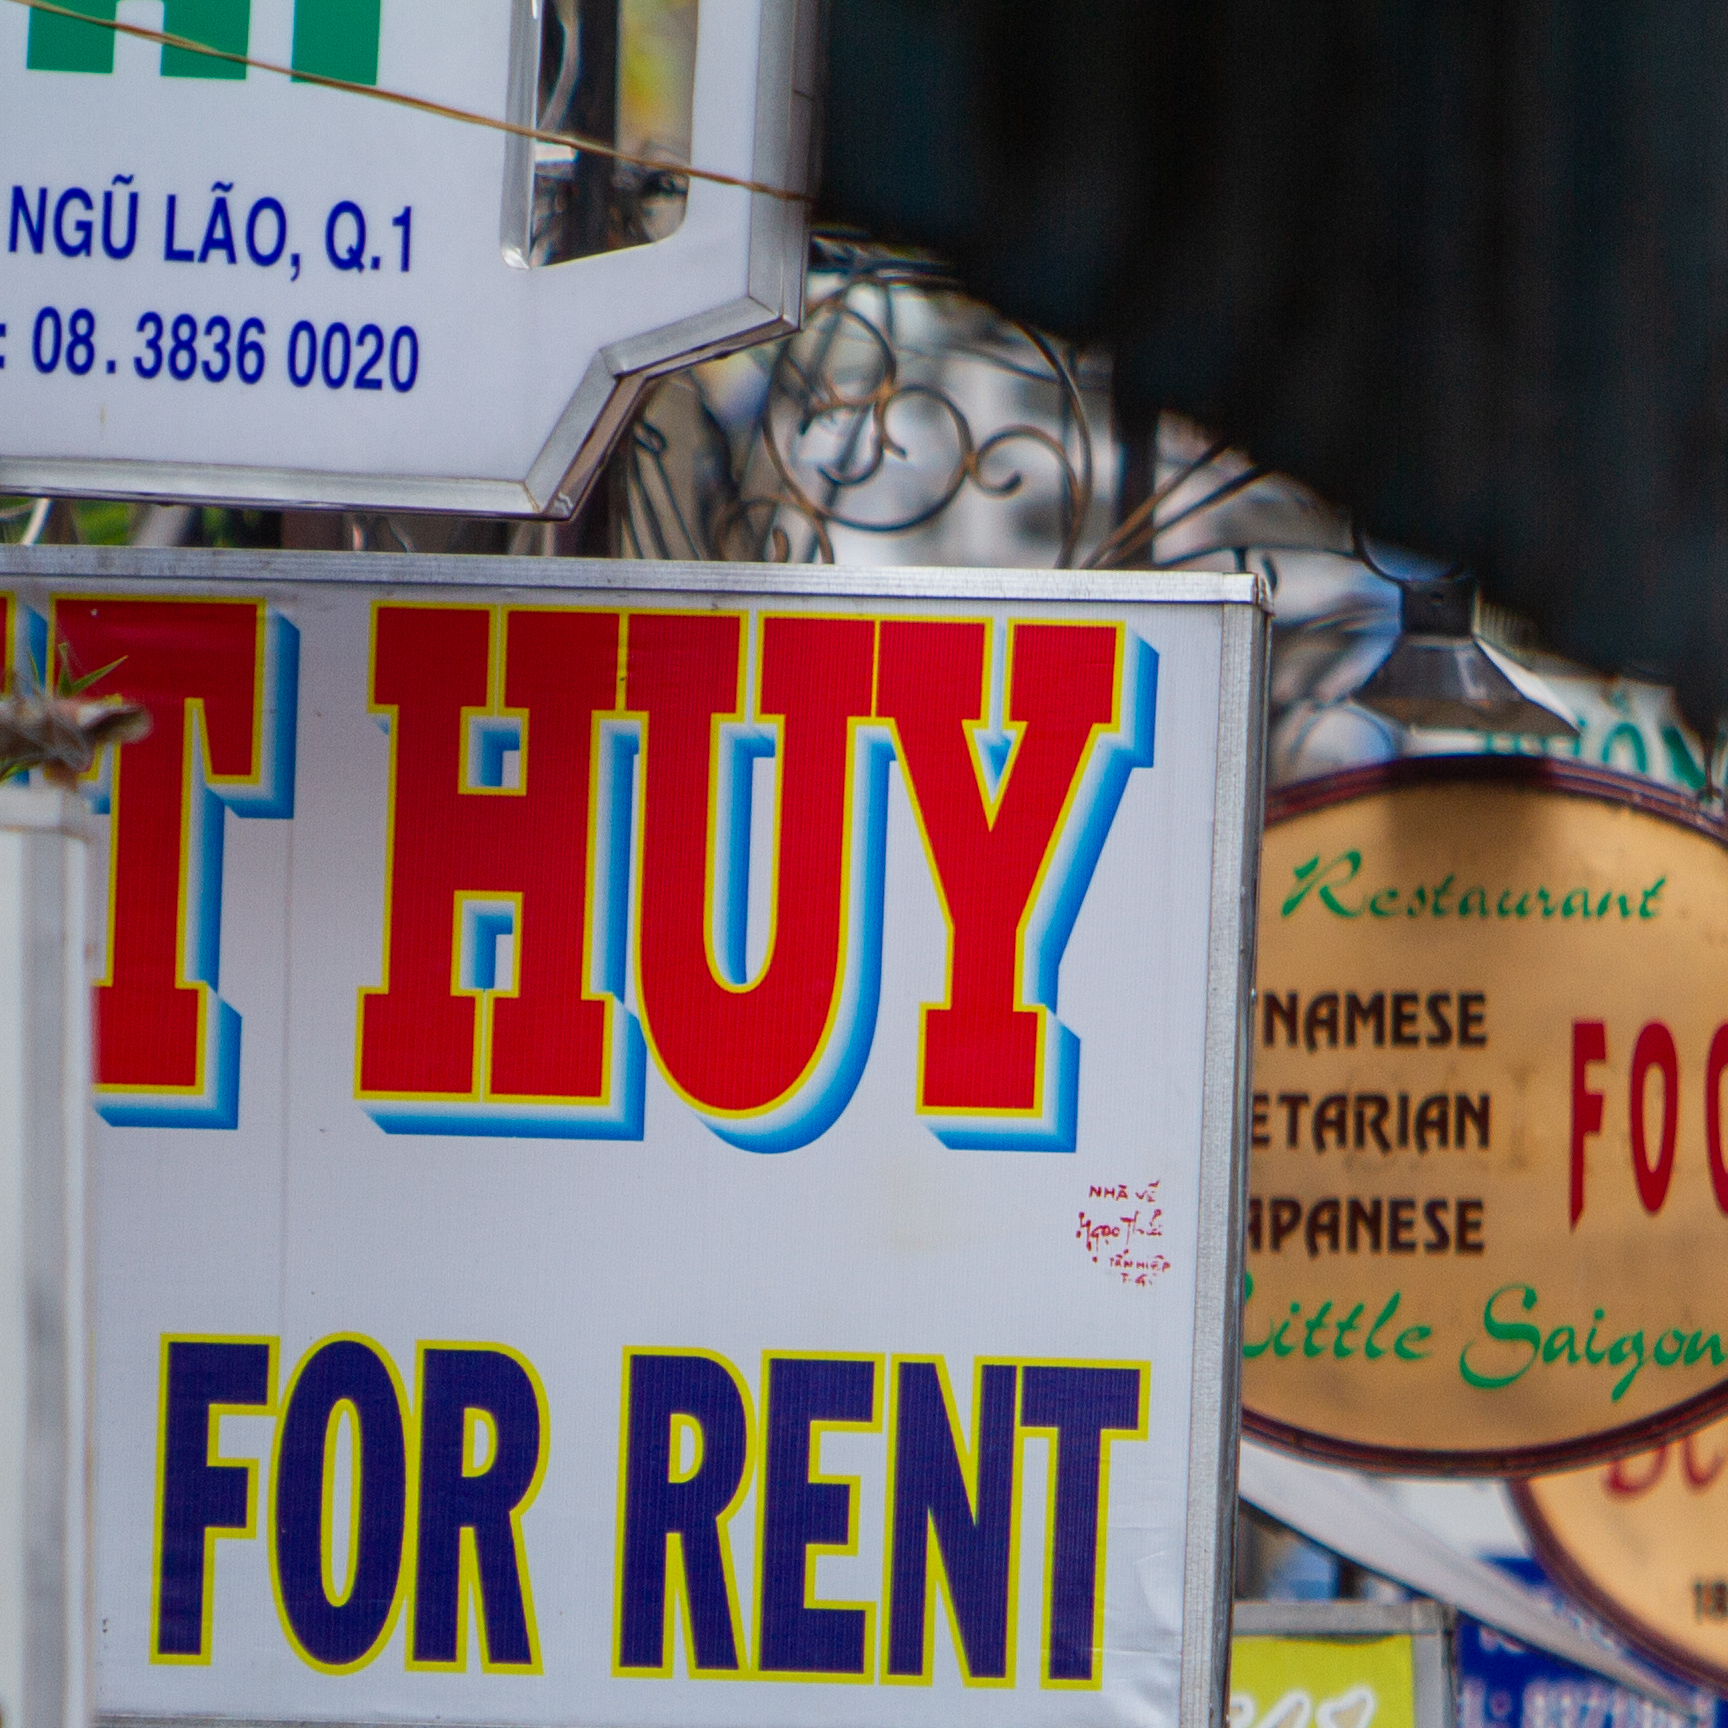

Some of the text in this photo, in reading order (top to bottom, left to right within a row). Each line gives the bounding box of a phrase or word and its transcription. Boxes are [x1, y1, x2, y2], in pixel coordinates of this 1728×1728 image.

[9, 174, 139, 260] NGŨ
[164, 181, 302, 282] LÃO,
[325, 200, 414, 274] Q.1
[287, 320, 420, 394] 0020
[353, 601, 1160, 1153] HUY
[1281, 848, 1668, 923] Restaurant
[1260, 988, 1488, 1054] NAMESE
[150, 1331, 1150, 1690] FOR RENT
